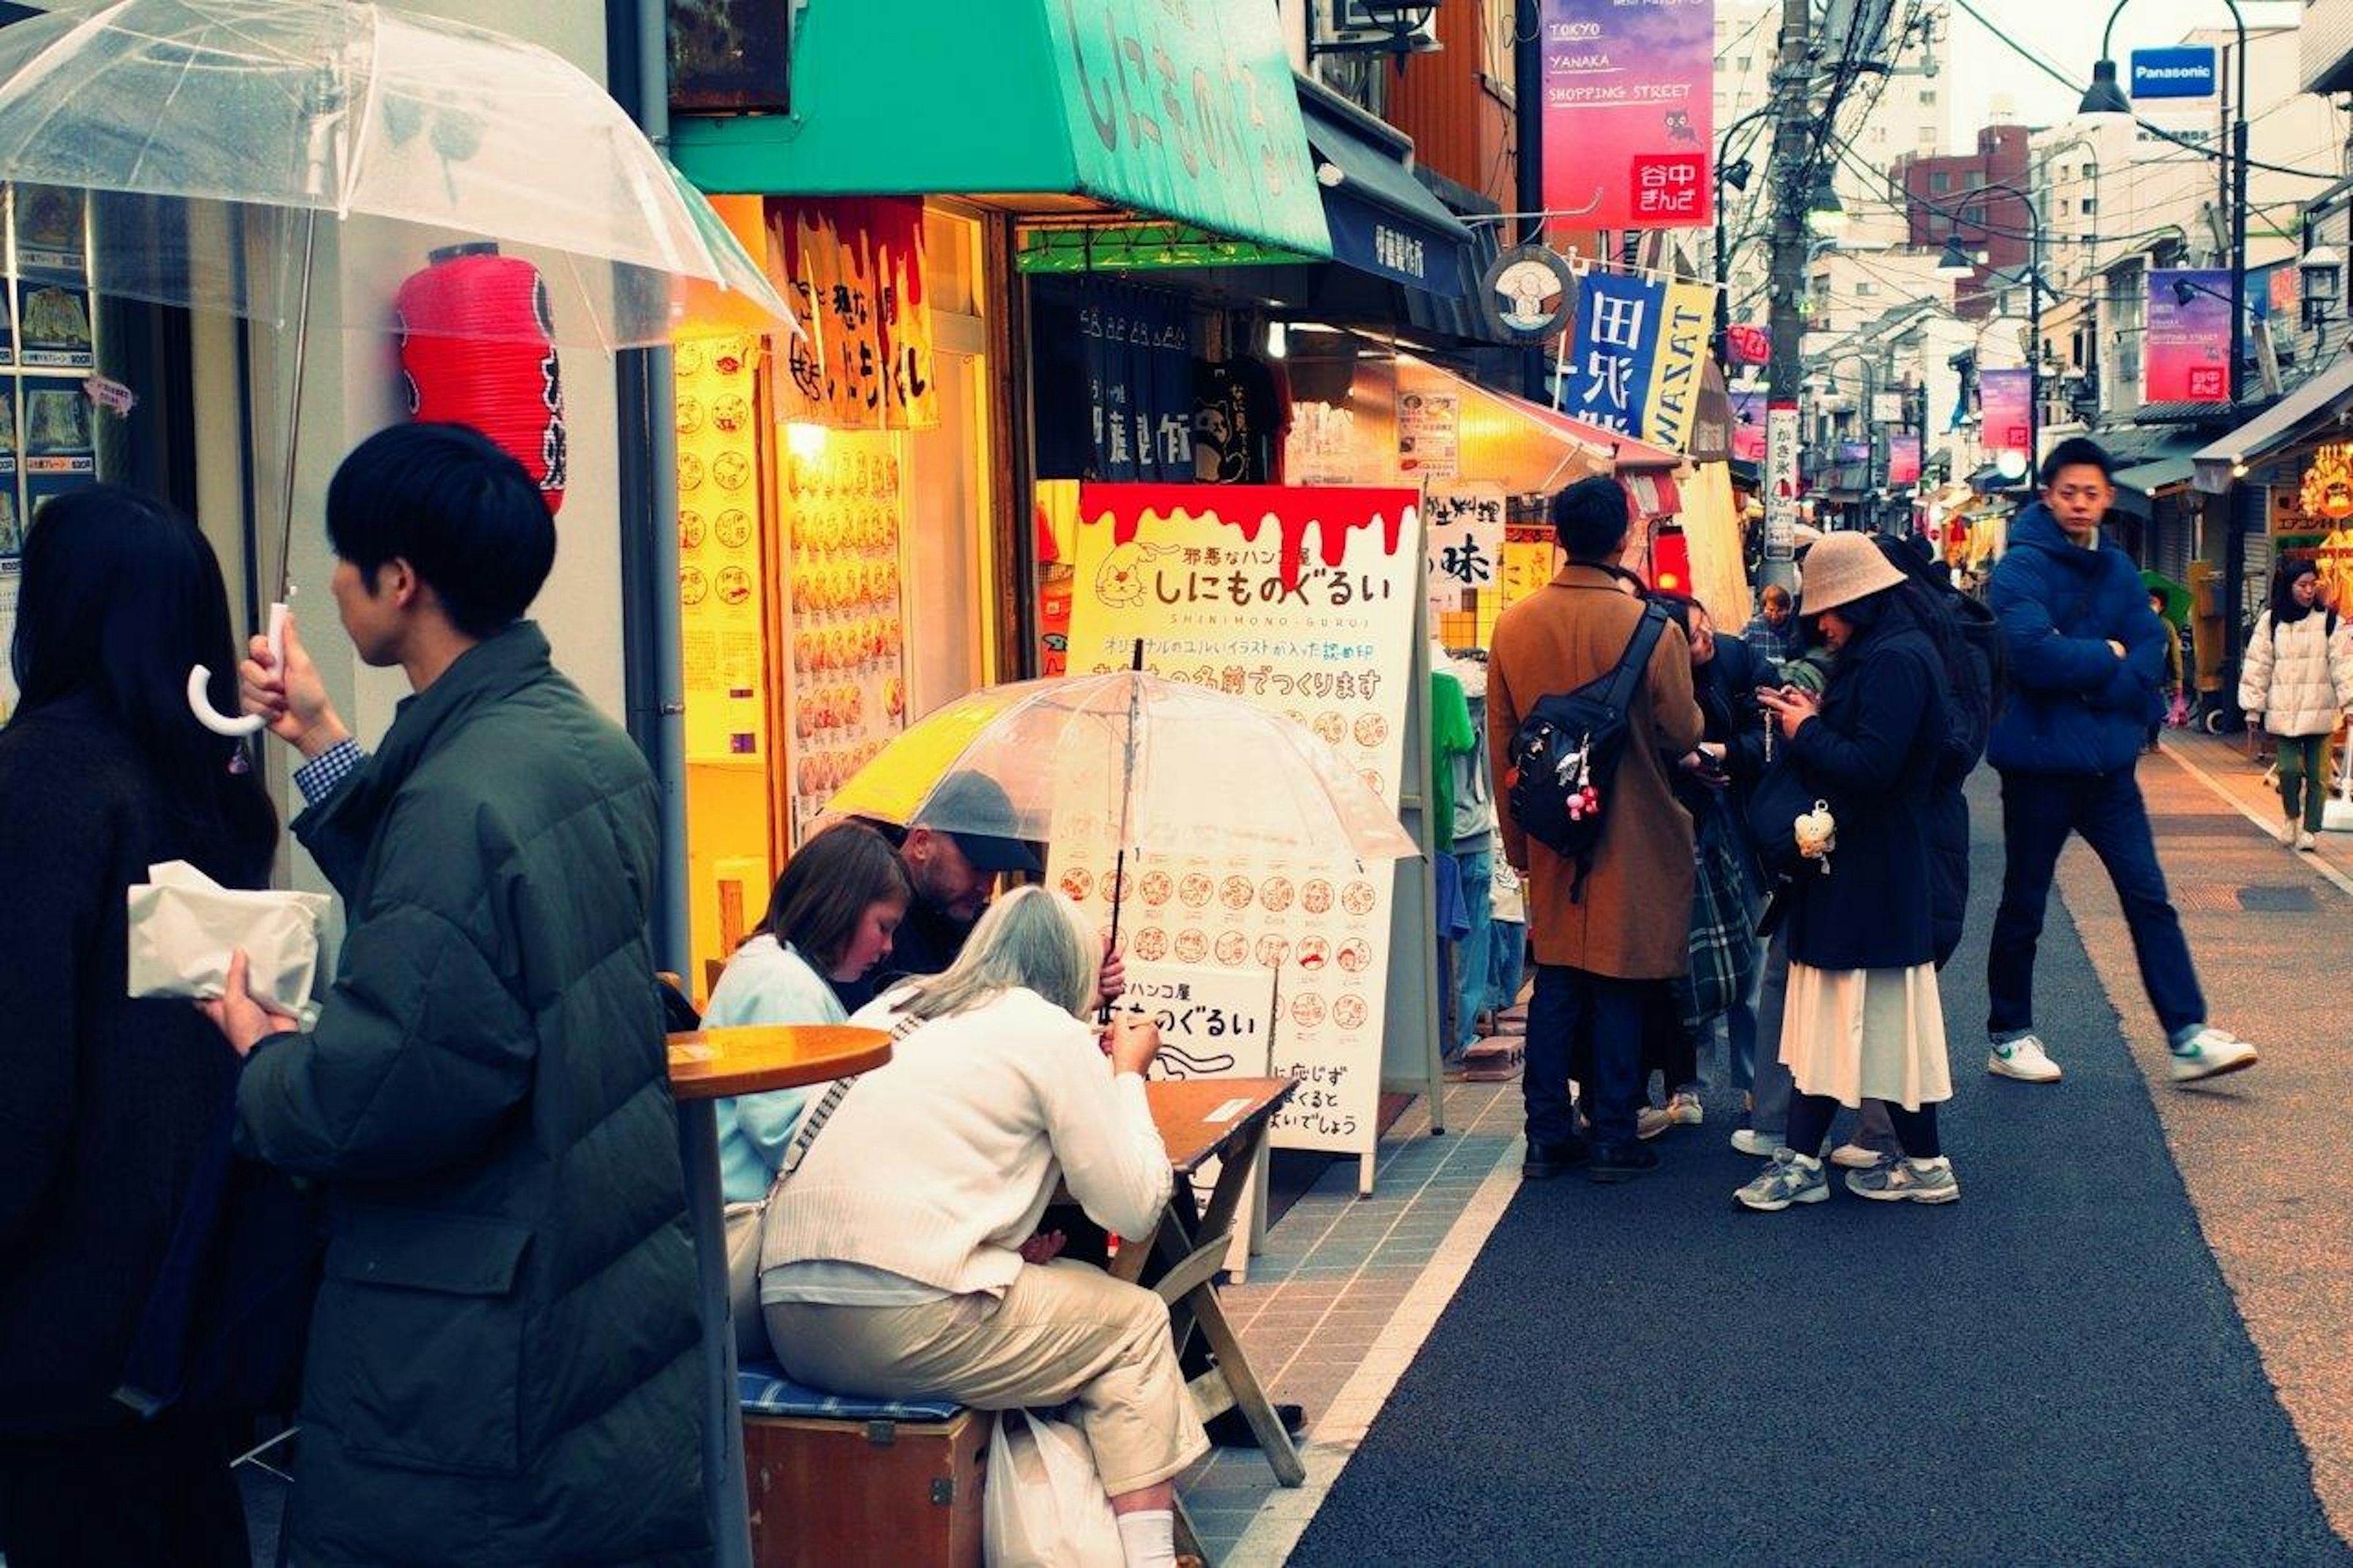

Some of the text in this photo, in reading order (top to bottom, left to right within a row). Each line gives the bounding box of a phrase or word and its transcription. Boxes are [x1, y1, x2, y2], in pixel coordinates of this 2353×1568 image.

[1549, 23, 1600, 37] TOKYO
[1549, 55, 1610, 69] YANAKA
[2136, 65, 2211, 78] Panasonic
[1548, 83, 1692, 102] SHOPPING STREET
[1640, 164, 1696, 187] 谷中
[1183, 545, 1313, 567] 邪悪なハン屋
[1155, 568, 1391, 607] しにものぐるい
